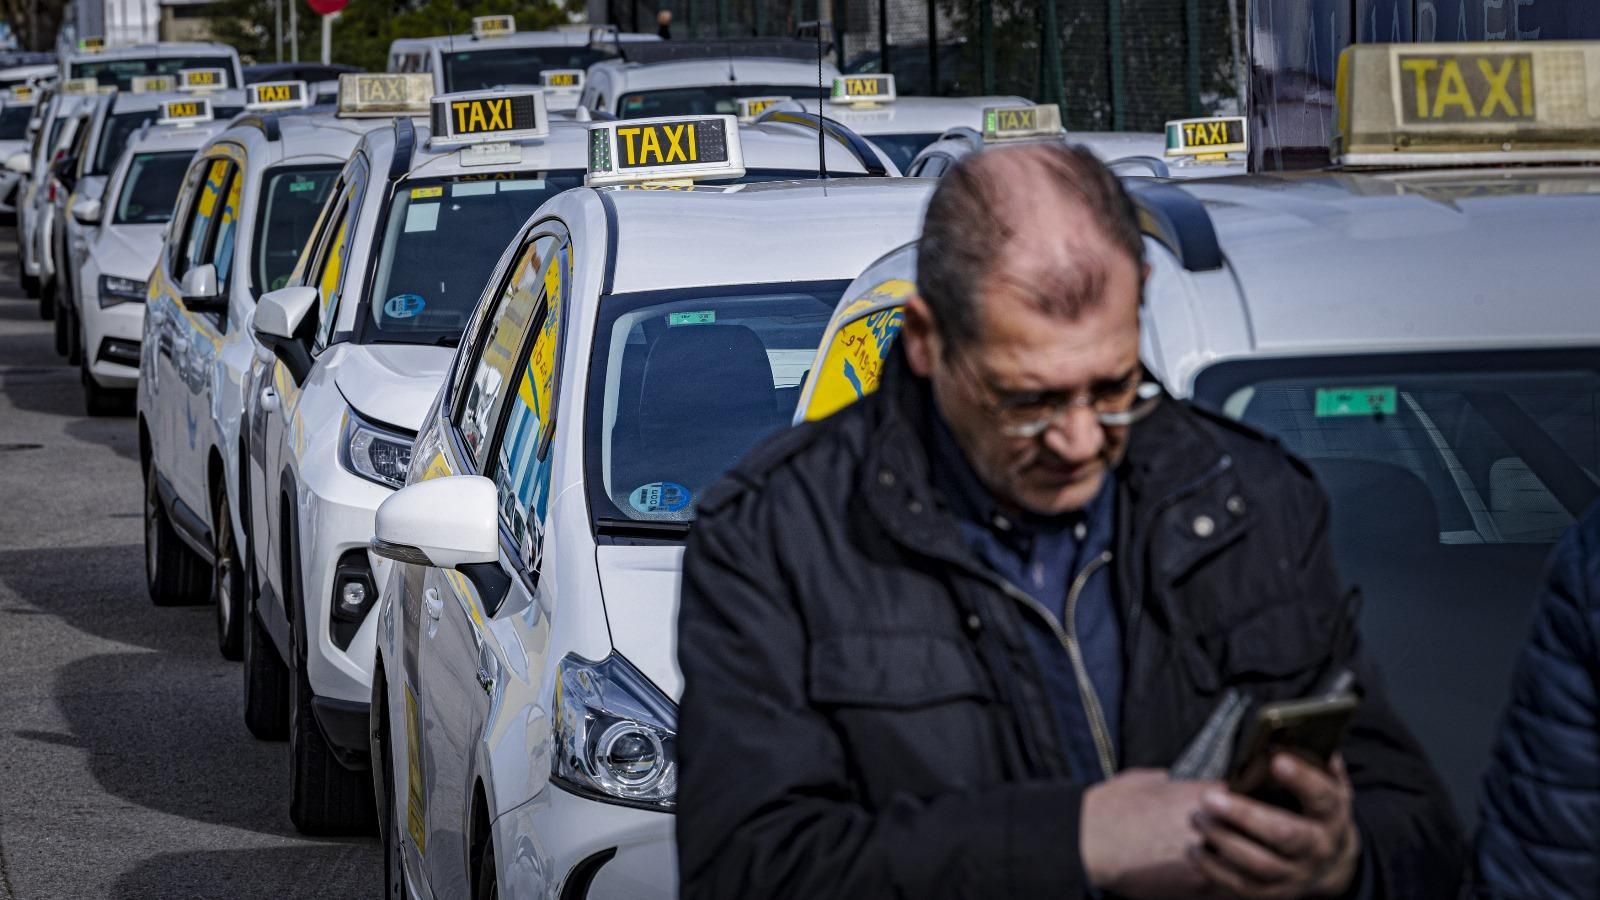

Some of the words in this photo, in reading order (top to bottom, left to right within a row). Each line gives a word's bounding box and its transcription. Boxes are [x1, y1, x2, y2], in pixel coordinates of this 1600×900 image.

[258, 85, 291, 102] TAXI
[359, 79, 406, 101] TAXI
[846, 78, 878, 95] TAXI
[1402, 58, 1533, 118] TAXI
[452, 99, 513, 133] TAXI
[999, 110, 1037, 130] TAXI
[617, 124, 698, 166] TAXI
[1184, 121, 1228, 147] TAXI
